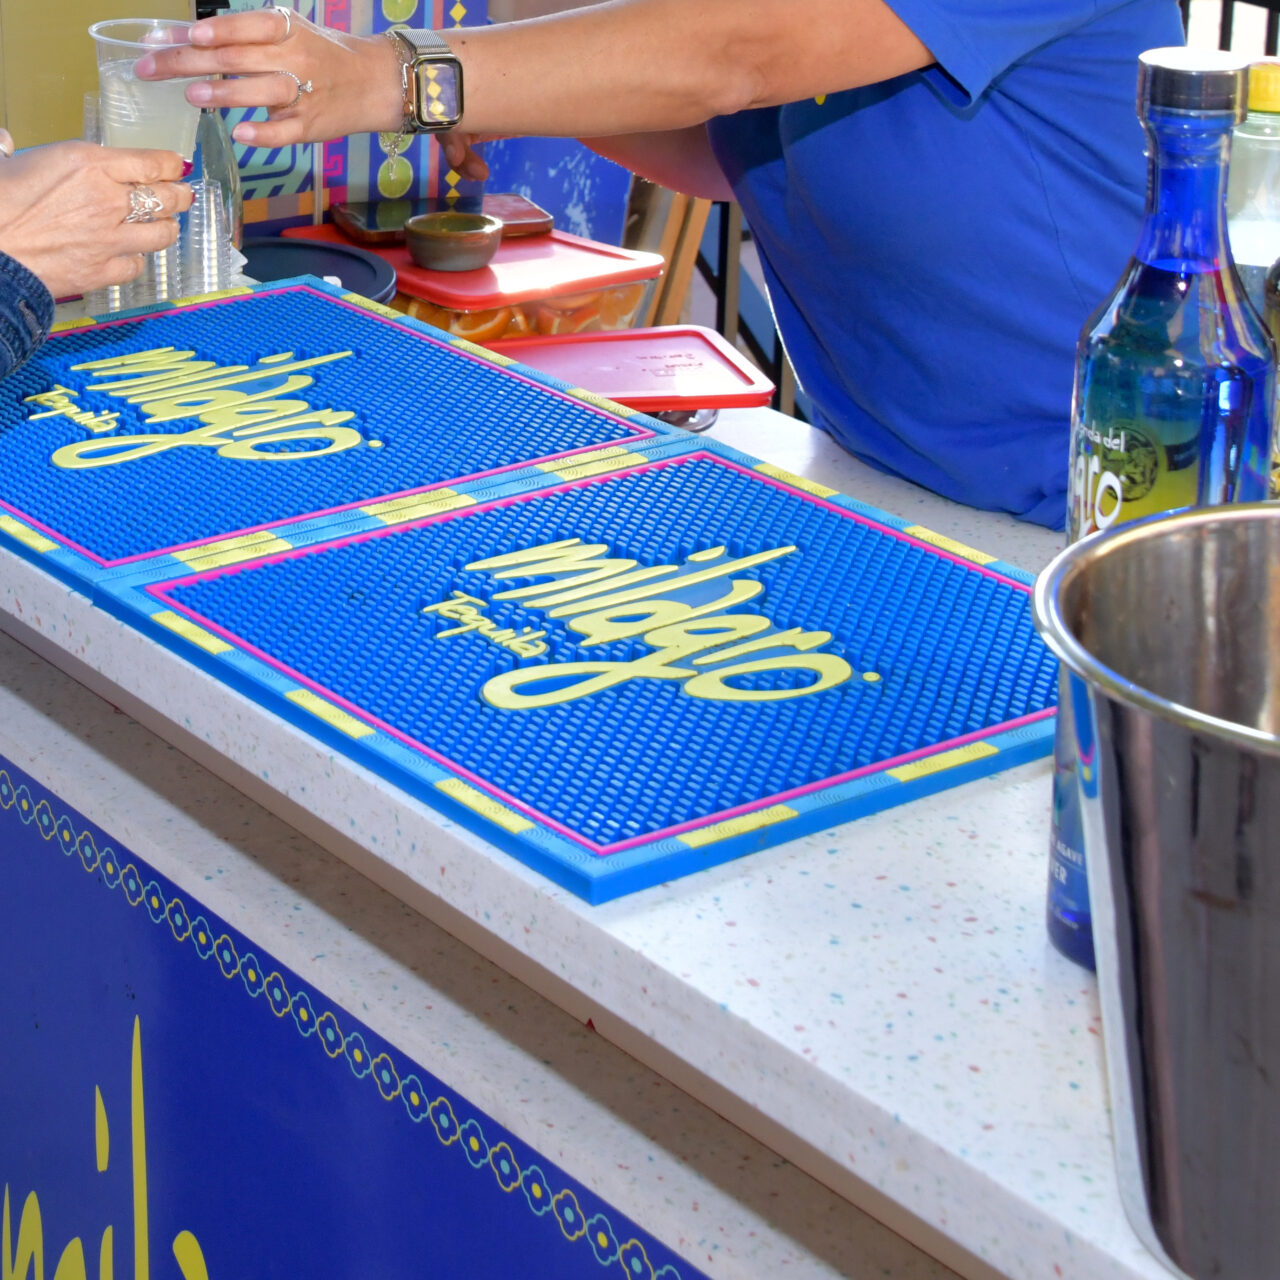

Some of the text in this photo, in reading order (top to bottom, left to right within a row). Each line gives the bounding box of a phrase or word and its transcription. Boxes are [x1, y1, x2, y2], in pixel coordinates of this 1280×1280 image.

[23, 383, 120, 433] Tequila
[1102, 427, 1125, 453] del
[422, 589, 547, 658] Tequila
